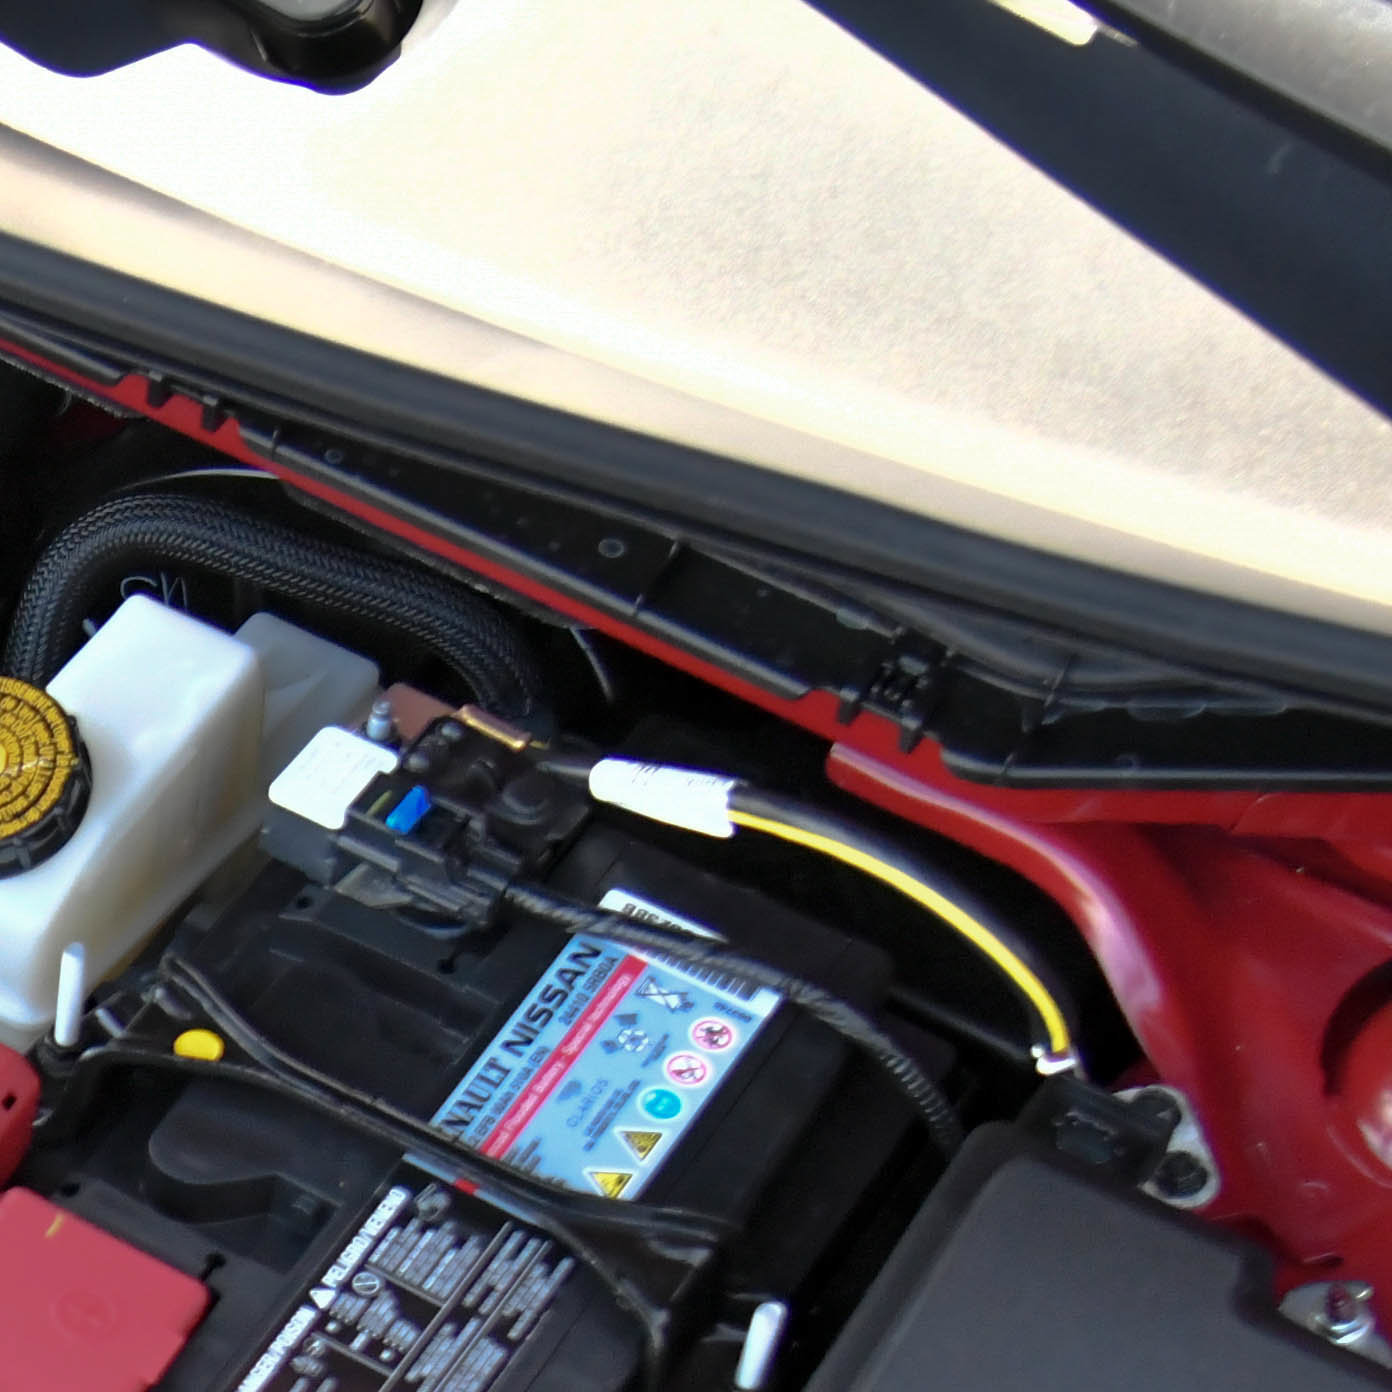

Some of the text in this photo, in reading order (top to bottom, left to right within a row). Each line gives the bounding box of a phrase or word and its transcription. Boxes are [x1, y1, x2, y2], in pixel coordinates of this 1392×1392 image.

[438, 940, 603, 1142] NAULT NISSAN
[320, 1186, 407, 1289] PELIGRO/VENENO
